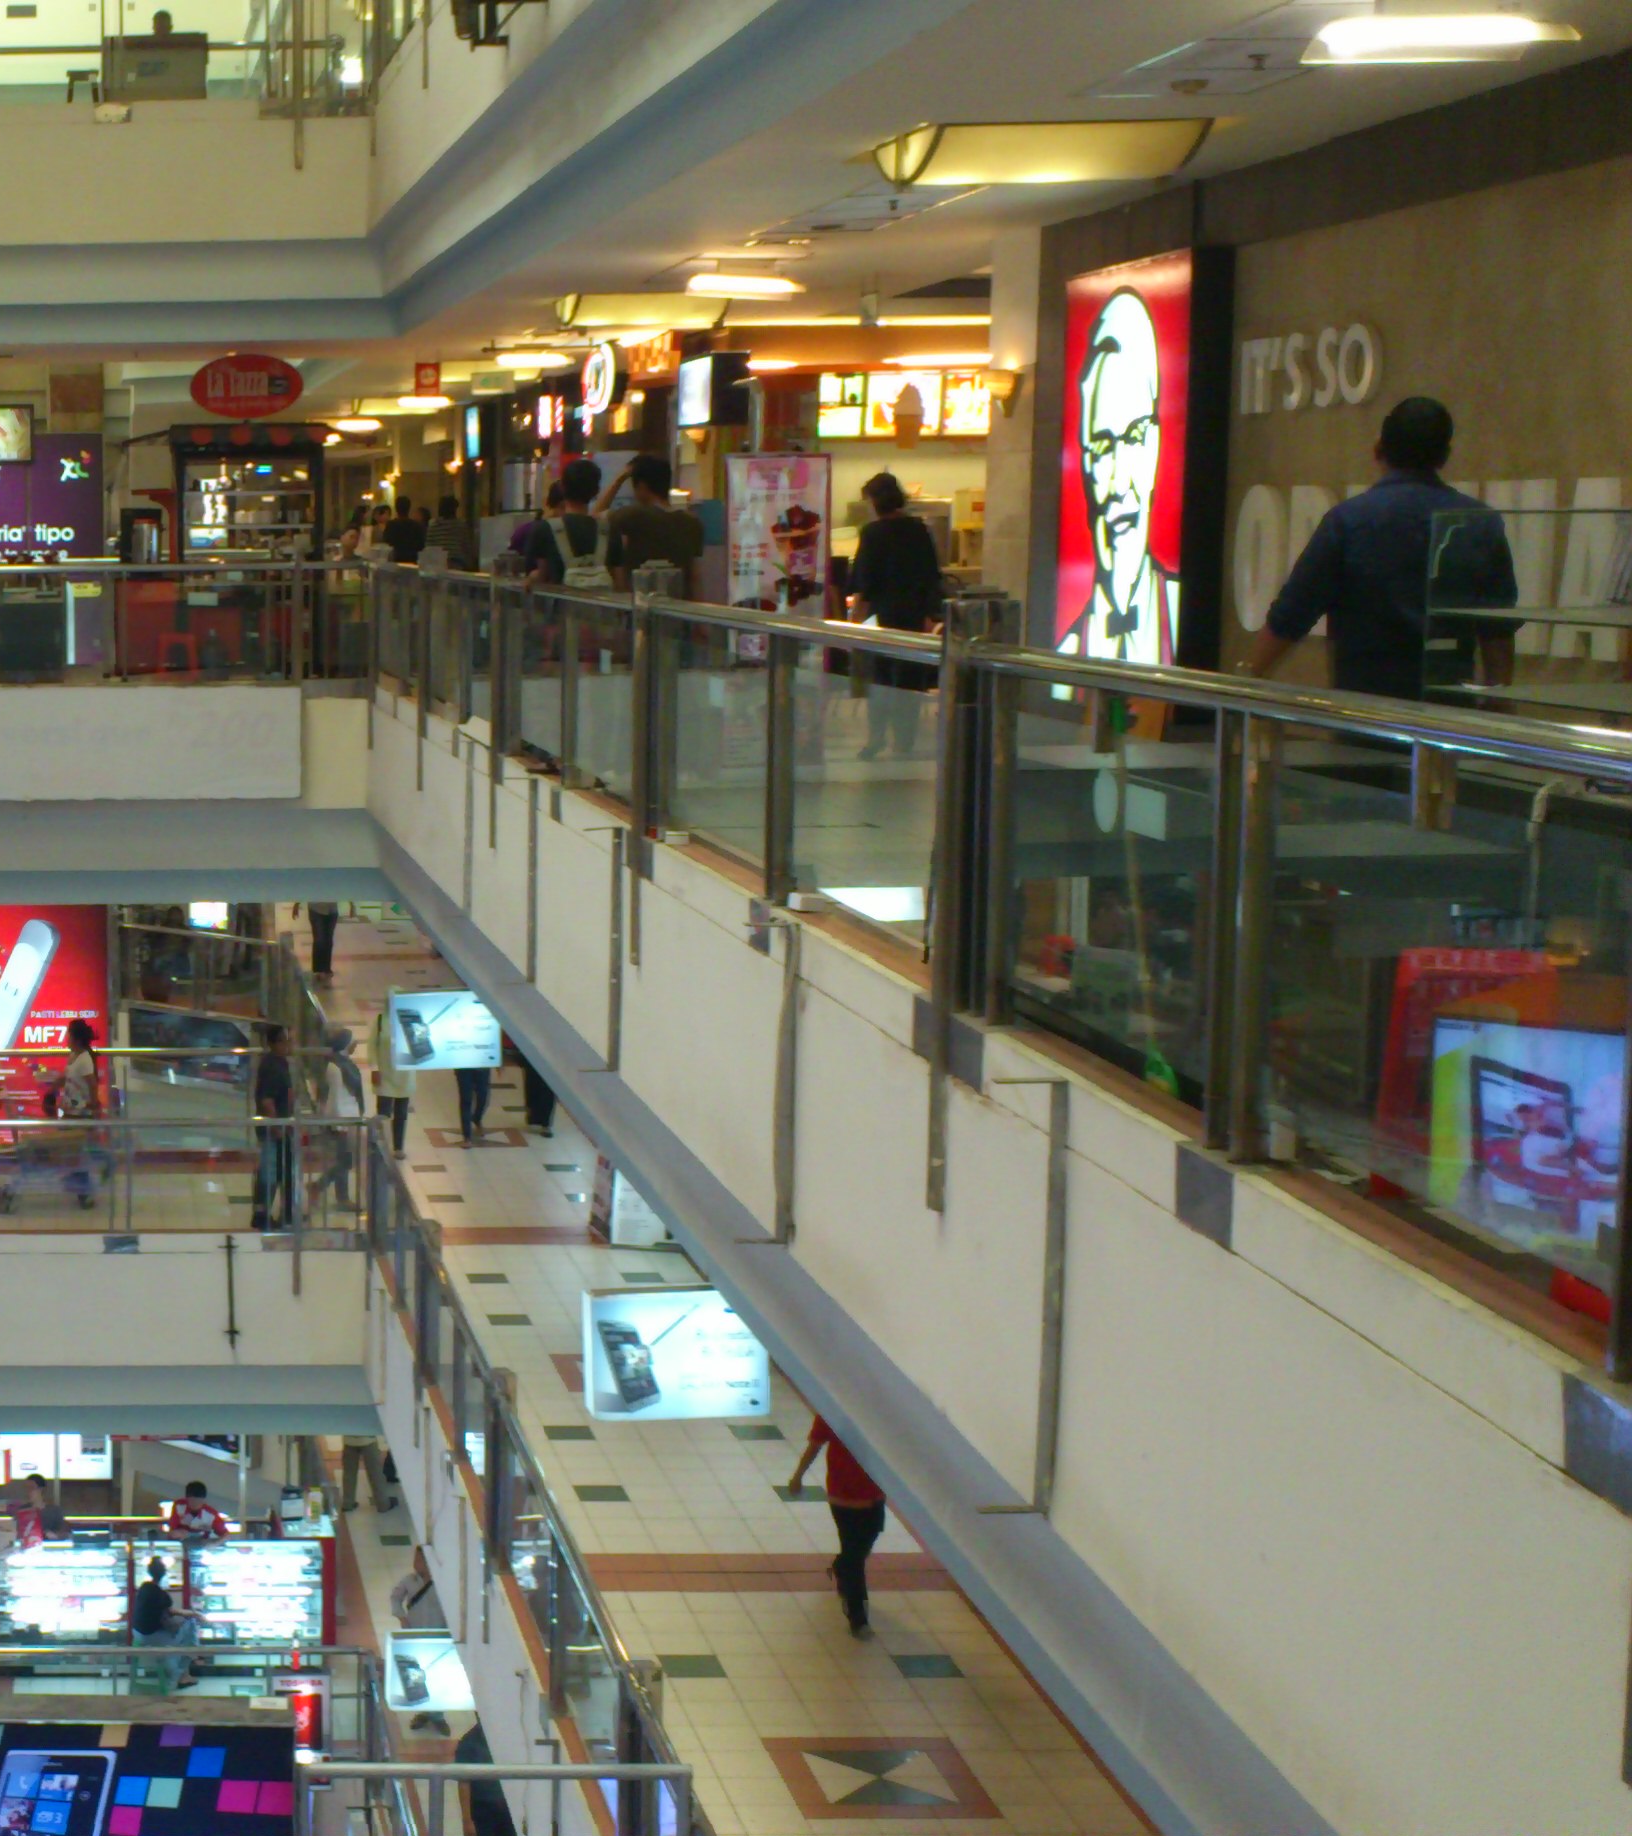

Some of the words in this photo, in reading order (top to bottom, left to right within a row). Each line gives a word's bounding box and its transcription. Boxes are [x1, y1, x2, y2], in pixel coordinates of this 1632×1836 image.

[1240, 332, 1306, 415] IT'S
[1313, 322, 1374, 408] SO
[34, 523, 75, 545] tipo
